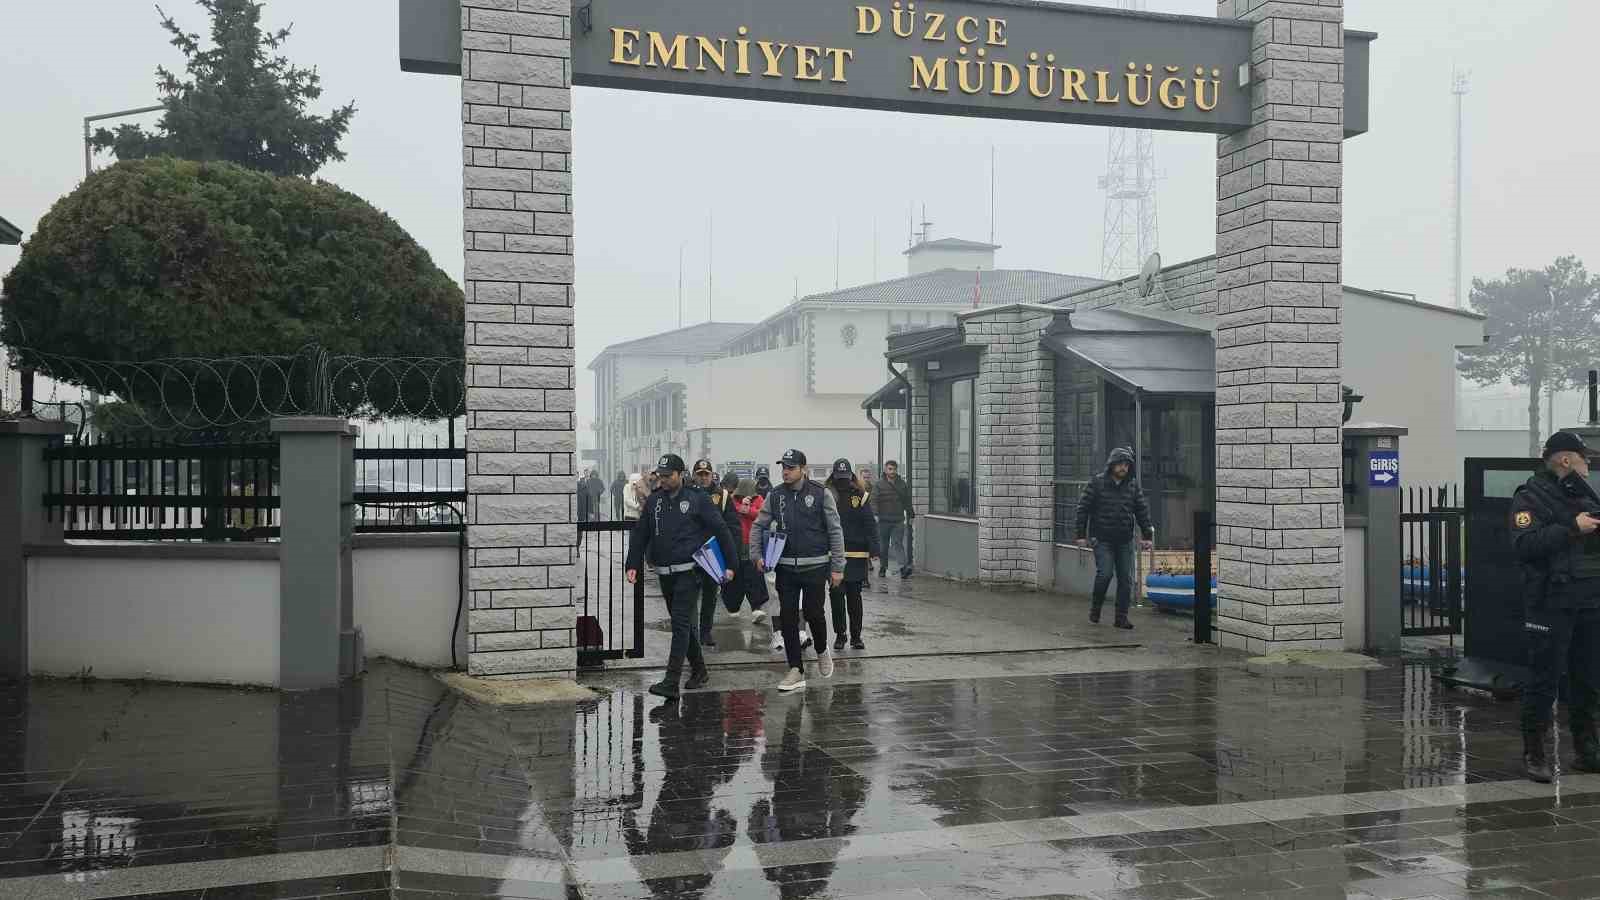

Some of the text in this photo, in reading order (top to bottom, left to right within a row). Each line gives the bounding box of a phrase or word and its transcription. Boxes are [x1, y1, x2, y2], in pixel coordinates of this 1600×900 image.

[856, 1, 1008, 46] DÜZCE
[609, 26, 1221, 111] EMNİYET MÜDÜRLÜĞÜ
